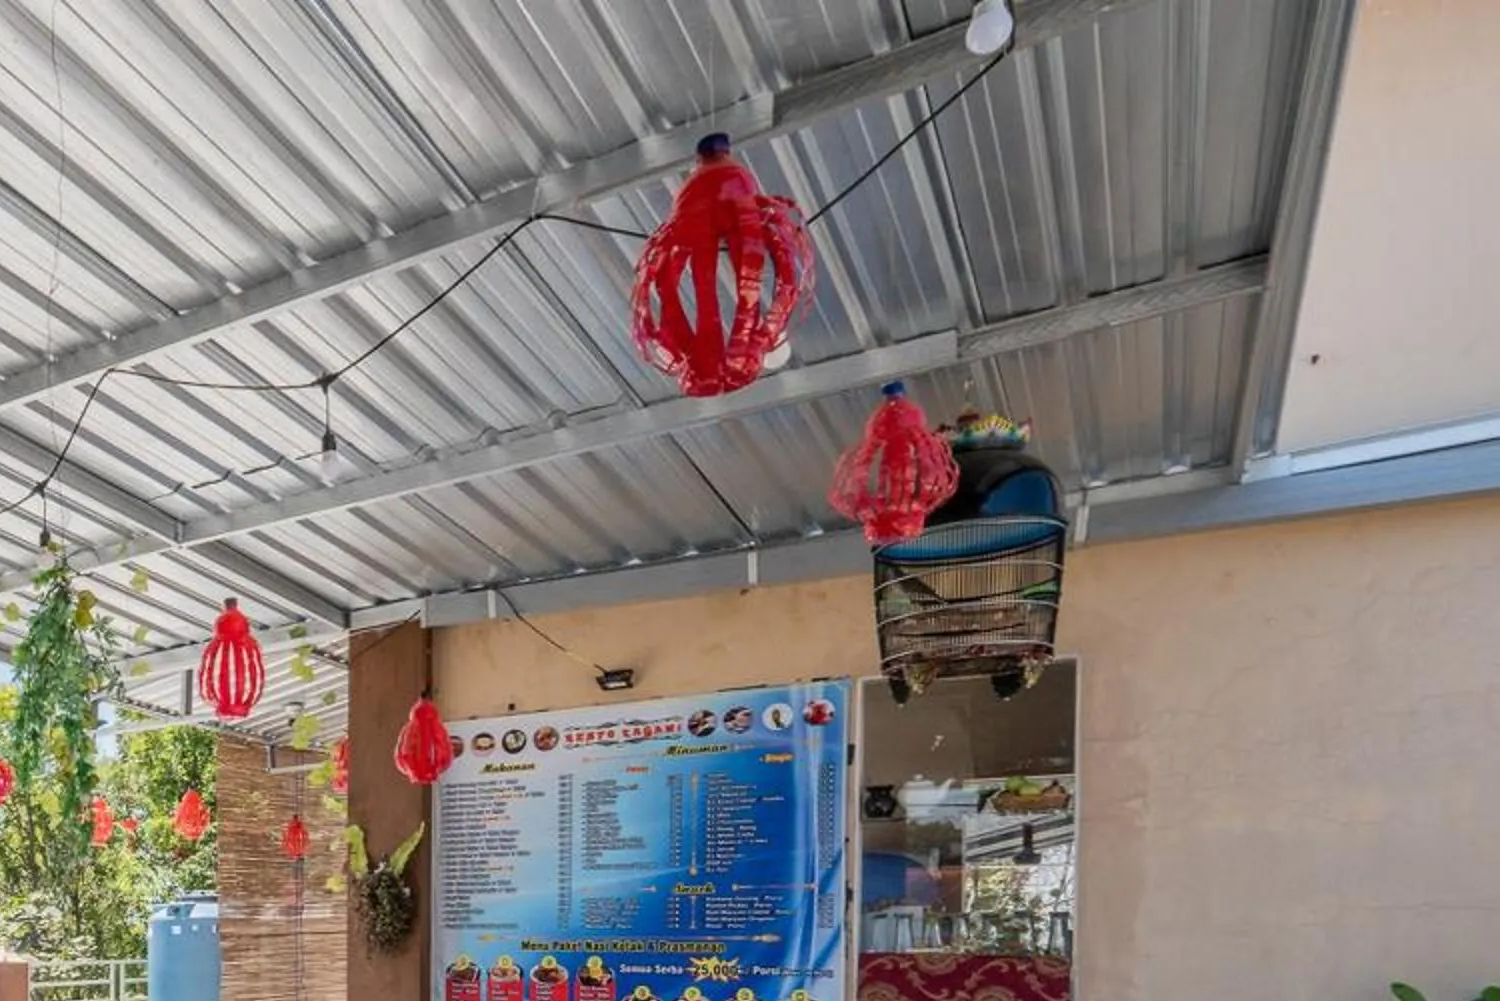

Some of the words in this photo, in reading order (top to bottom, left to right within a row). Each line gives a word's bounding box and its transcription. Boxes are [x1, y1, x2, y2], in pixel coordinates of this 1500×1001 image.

[521, 939, 549, 951] Menu
[551, 939, 581, 951] Paket
[585, 939, 609, 951] Nasi
[612, 939, 645, 952] Kotak
[619, 963, 652, 974] Semua
[654, 963, 684, 975] Serba
